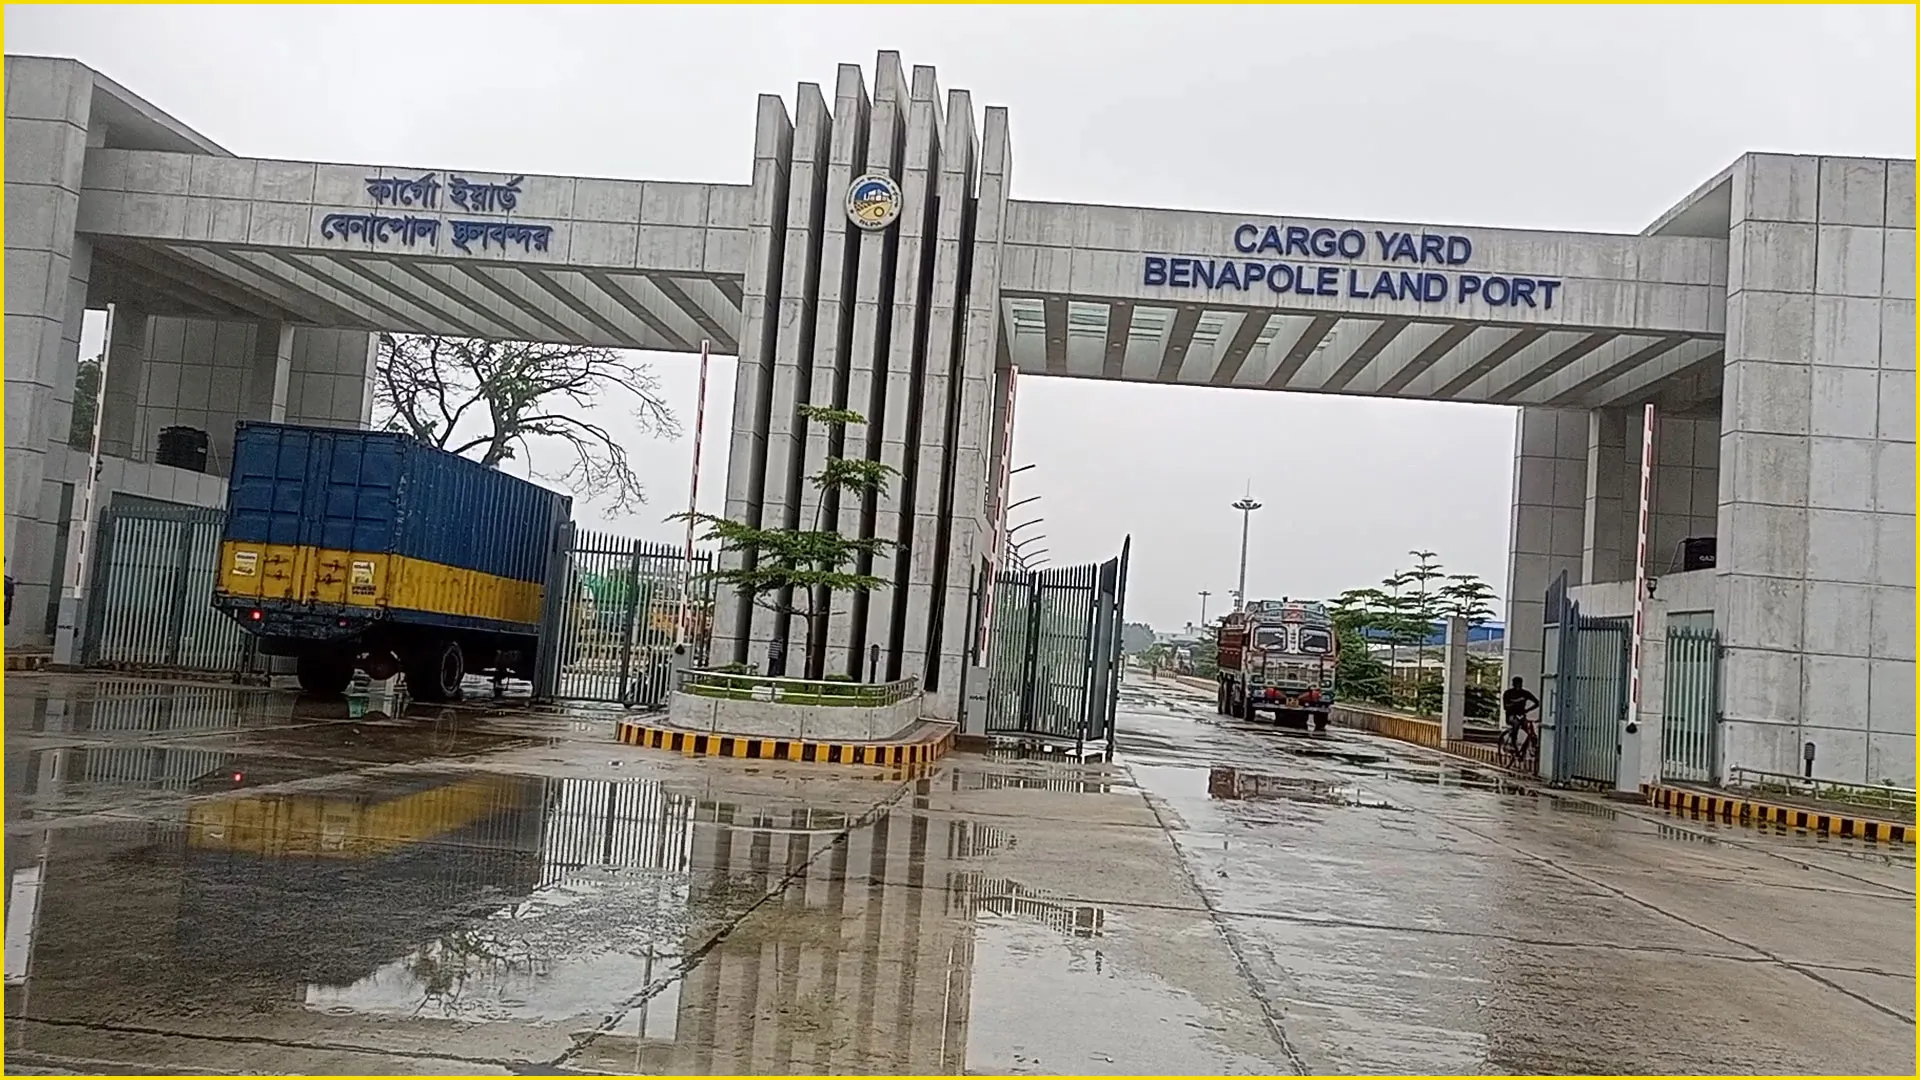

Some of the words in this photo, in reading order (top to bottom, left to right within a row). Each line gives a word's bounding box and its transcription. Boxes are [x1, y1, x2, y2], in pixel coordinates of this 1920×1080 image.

[365, 172, 441, 209] কার্গো
[448, 172, 524, 212] ইয়ার্ড
[321, 213, 441, 247] বেনাপোল
[448, 219, 553, 254] স্থলবন্দর
[1234, 223, 1366, 258] CARGO
[1376, 231, 1473, 265] YARD
[1143, 256, 1338, 296] BENAPOLE
[1349, 270, 1449, 301] LAND
[1458, 275, 1561, 310] PORT
